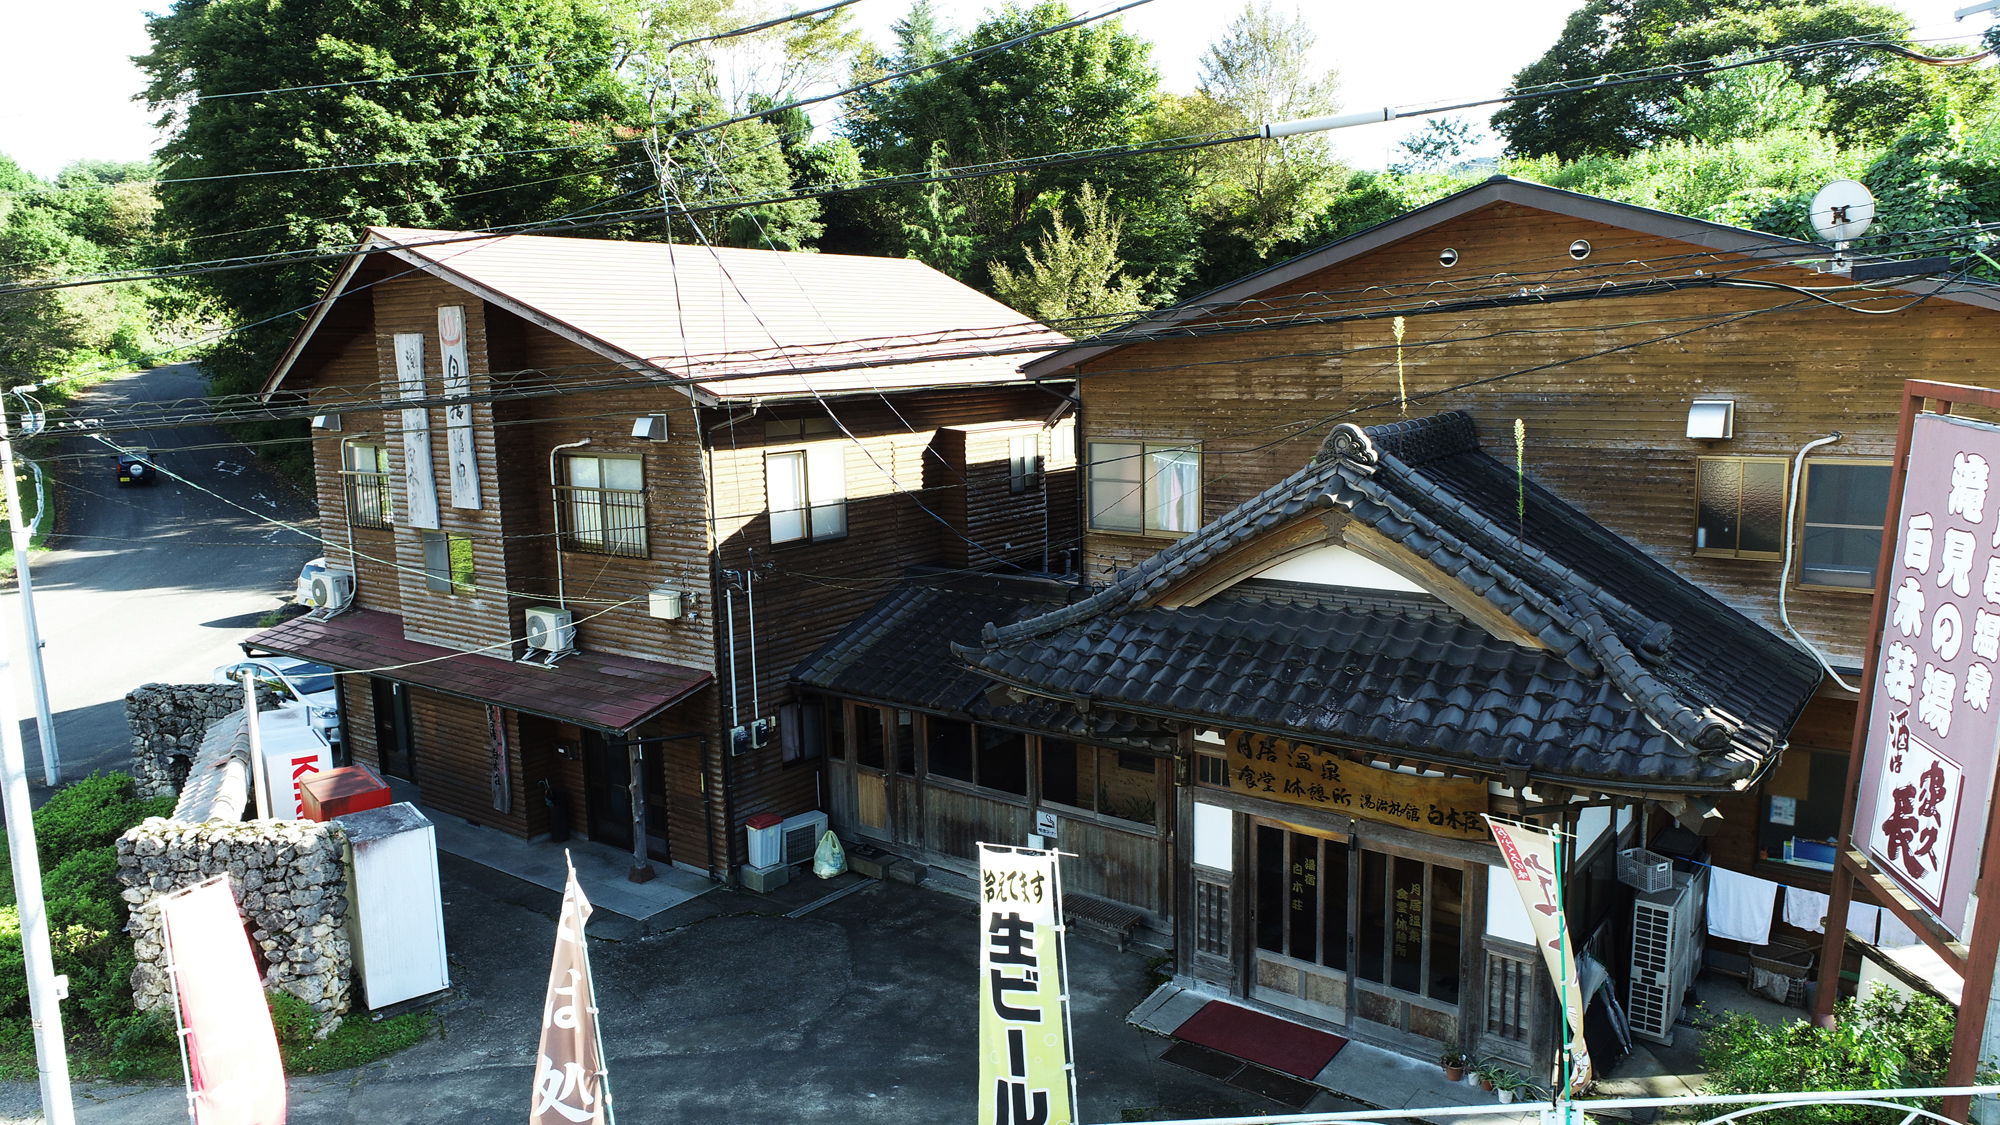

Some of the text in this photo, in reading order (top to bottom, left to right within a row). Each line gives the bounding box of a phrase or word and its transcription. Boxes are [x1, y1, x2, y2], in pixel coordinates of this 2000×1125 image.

[1884, 511, 1934, 706] 白木荘
[1917, 451, 1990, 739] 滝見の湯
[1963, 507, 2000, 713] 居温泉
[1888, 708, 1910, 774] 酒は
[1238, 765, 1484, 833] 食堂 休憩所 湯治旅館 白木荘
[983, 868, 1045, 904] 冷えてます
[1292, 863, 1303, 911] 白木荘
[1304, 858, 1316, 886] 湯宿
[1409, 883, 1421, 943] 月居温泉
[989, 912, 1049, 1125] 生ビール
